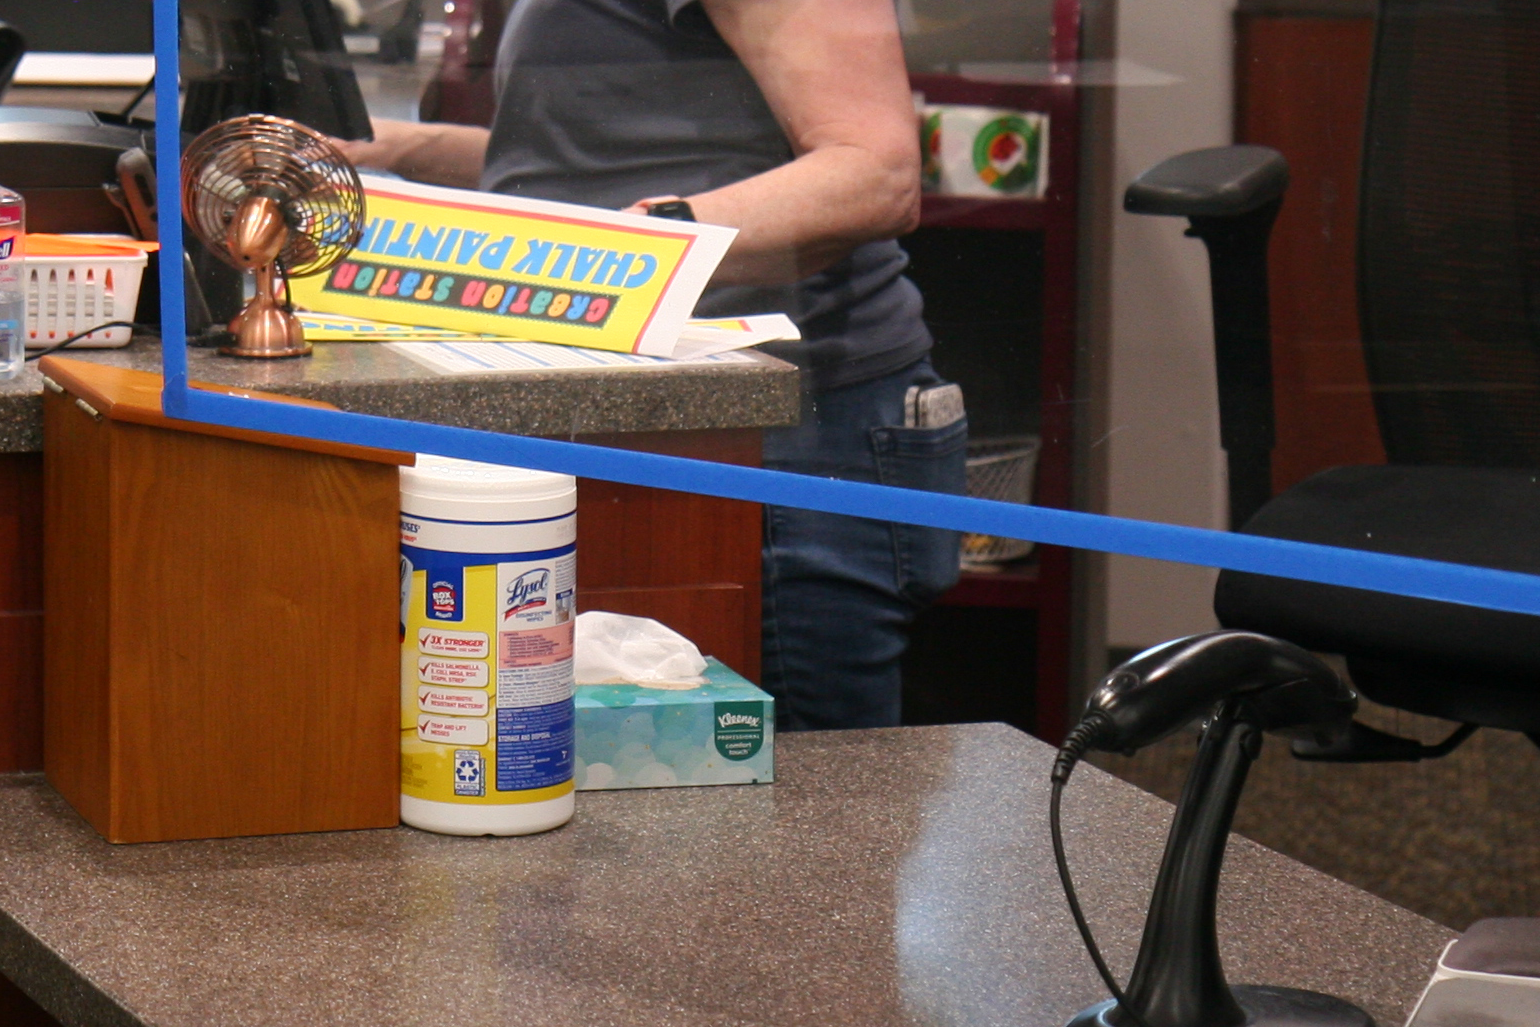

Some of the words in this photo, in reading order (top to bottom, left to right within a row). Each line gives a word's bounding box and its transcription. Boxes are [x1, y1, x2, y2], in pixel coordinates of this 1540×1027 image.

[513, 238, 658, 289] CHALK
[433, 592, 450, 600] BOX
[507, 572, 547, 605] Lysol
[430, 635, 443, 645] 3X
[718, 712, 760, 728] Kleenex
